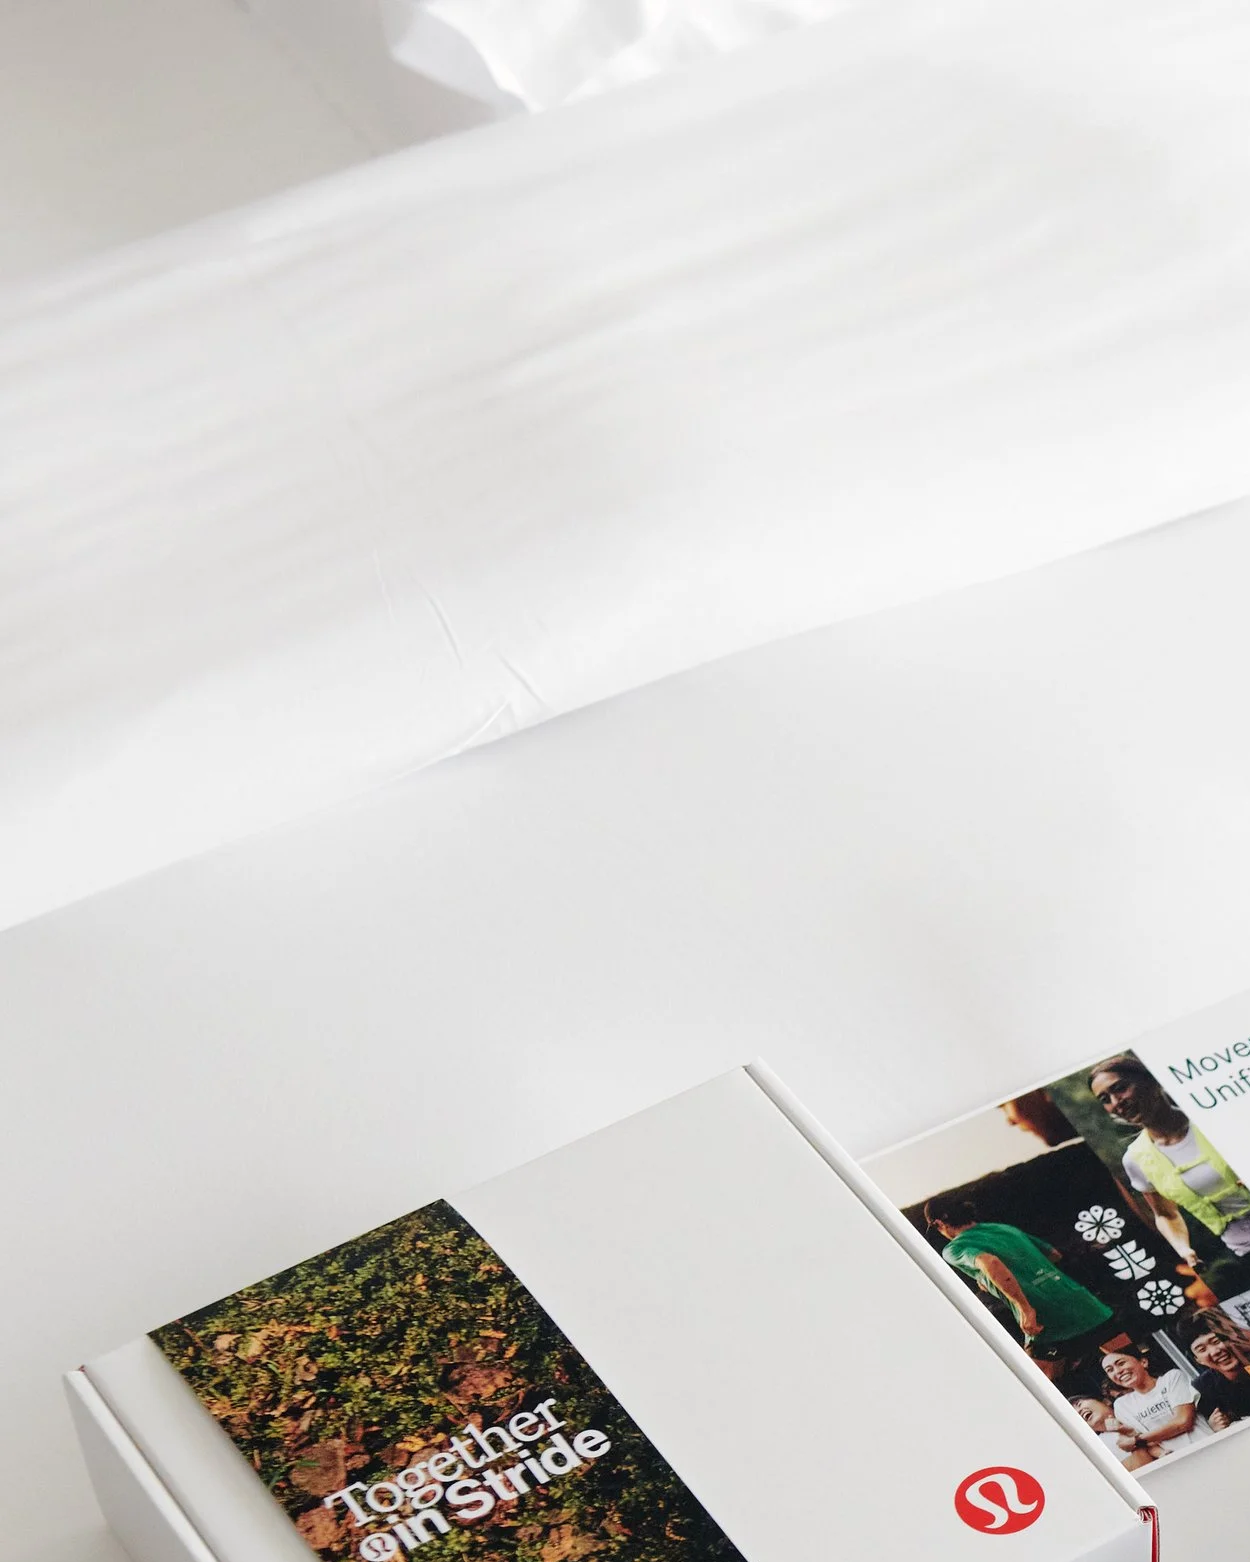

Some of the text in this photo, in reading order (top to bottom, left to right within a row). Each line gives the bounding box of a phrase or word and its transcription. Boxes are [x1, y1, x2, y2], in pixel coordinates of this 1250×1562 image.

[324, 1399, 567, 1526] Together
[386, 1429, 611, 1550] in Stride
